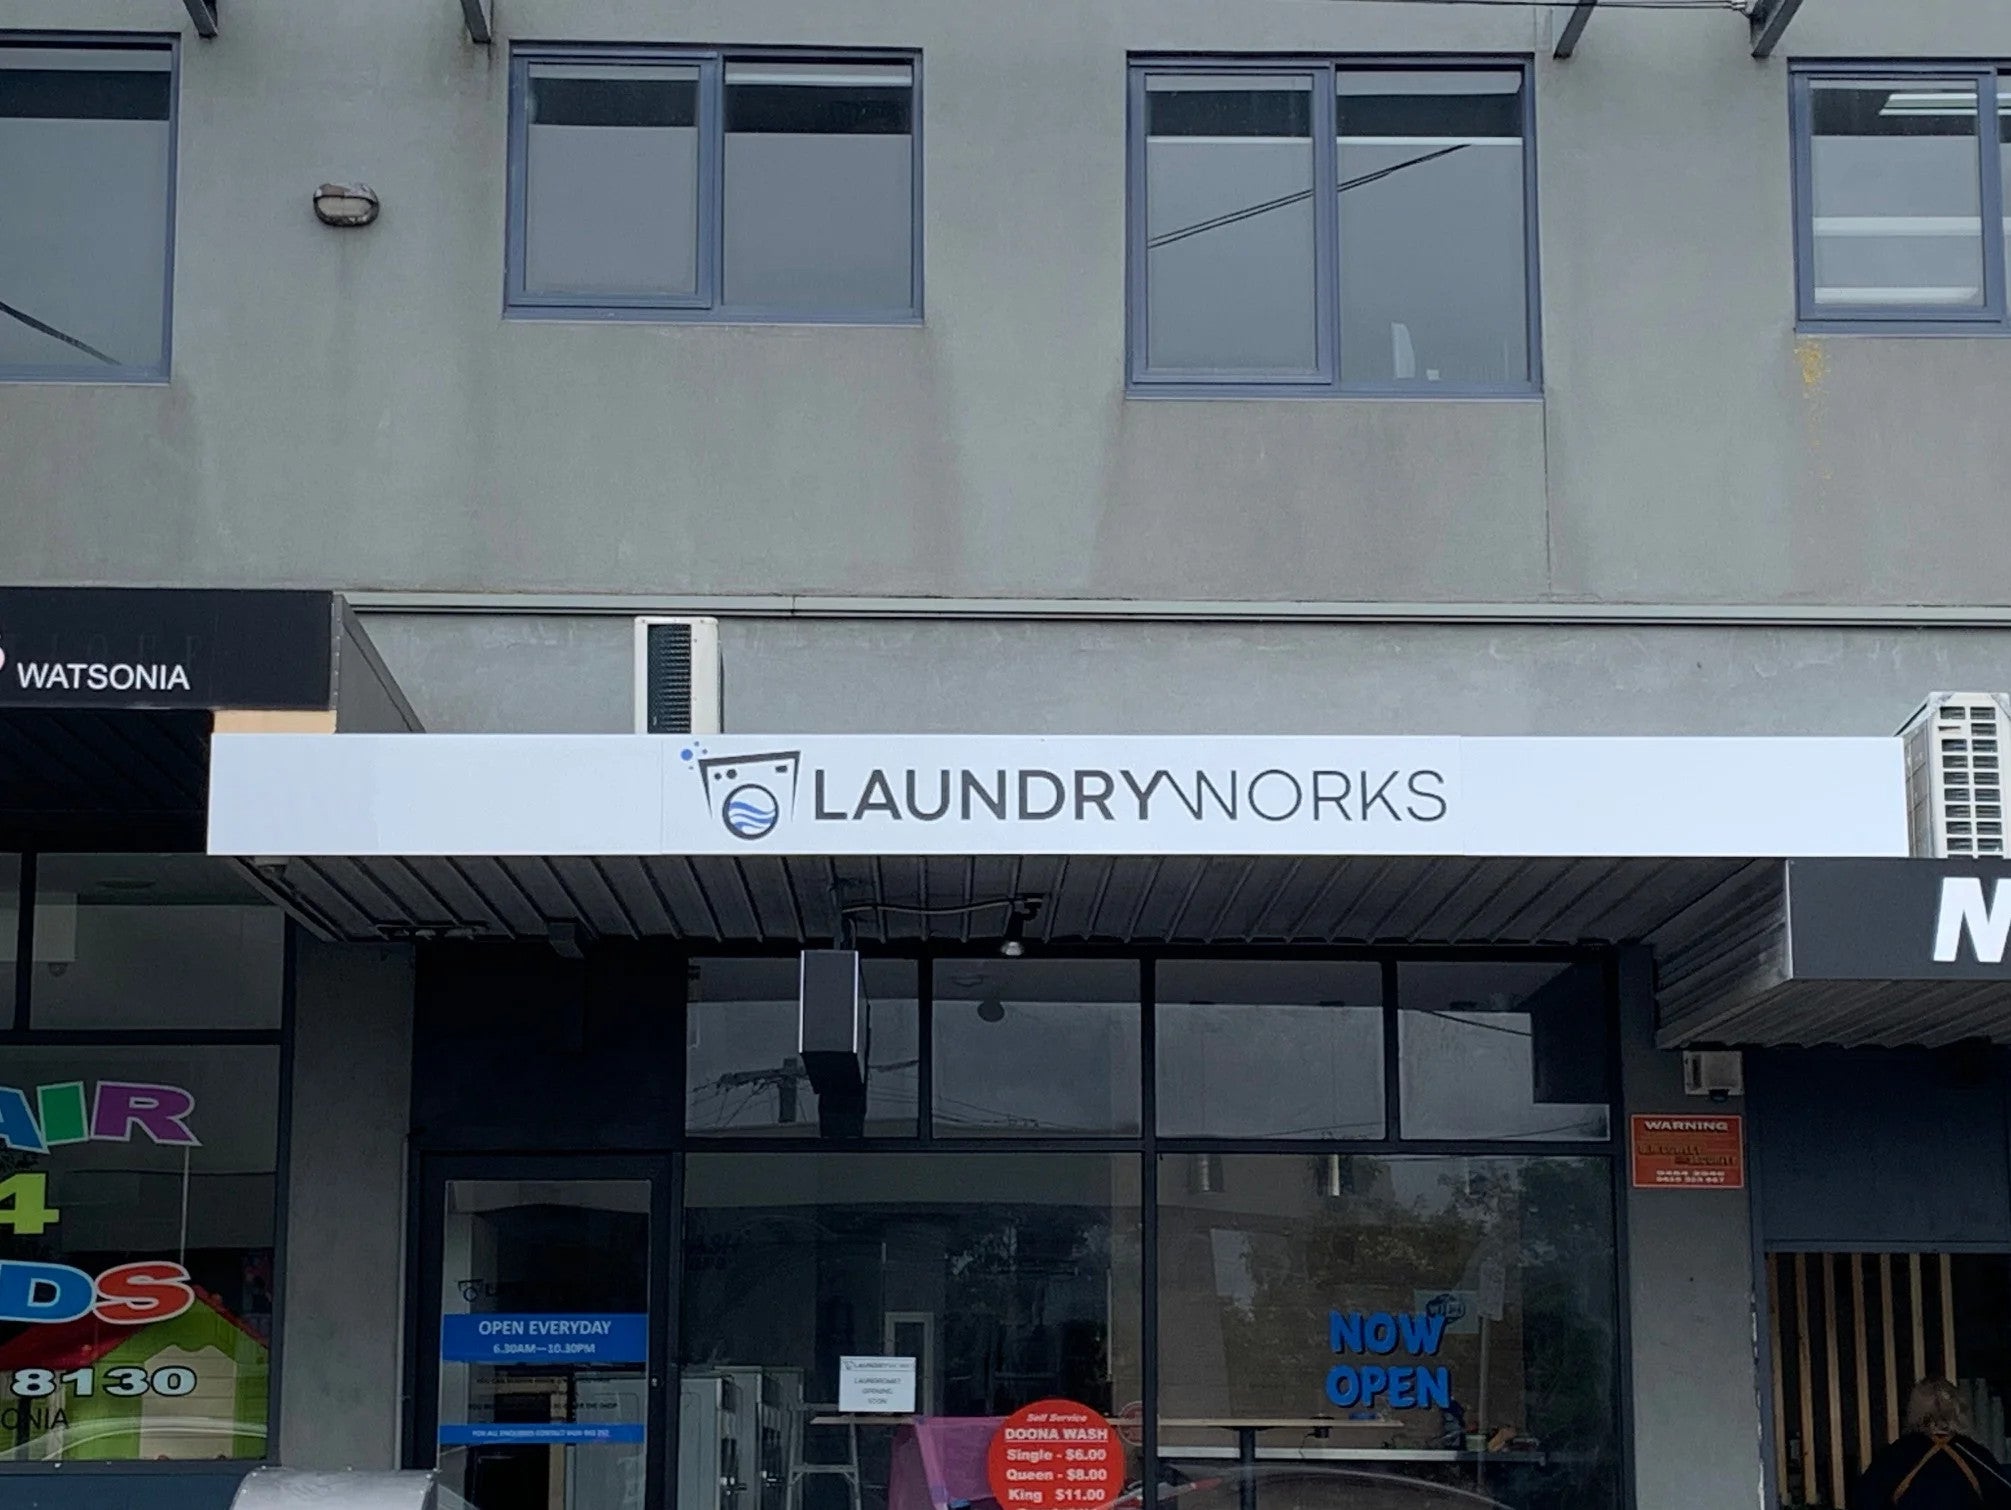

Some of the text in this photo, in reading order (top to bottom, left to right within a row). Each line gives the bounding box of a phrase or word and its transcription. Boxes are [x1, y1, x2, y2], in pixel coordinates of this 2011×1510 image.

[17, 662, 190, 692] WATSONIA
[814, 768, 1447, 823] LAUNDRYWORKS
[1644, 1120, 1729, 1131] WARNING
[0, 1171, 60, 1236] 4
[0, 1259, 196, 1325] DS
[478, 1320, 611, 1335] OPEN EVERYDAY
[1328, 1308, 1447, 1356] NOW
[10, 1365, 198, 1399] 8130
[1325, 1363, 1452, 1409] OPEN
[1, 1408, 69, 1430] ONIA
[1026, 1413, 1088, 1422] Self Service
[1005, 1428, 1108, 1440] DOONA WASH
[1006, 1448, 1053, 1463] Single
[1065, 1448, 1107, 1461] $6.00
[1006, 1468, 1054, 1481] Queen
[1065, 1468, 1107, 1481] $8.00
[1008, 1488, 1106, 1503] King $11.00
